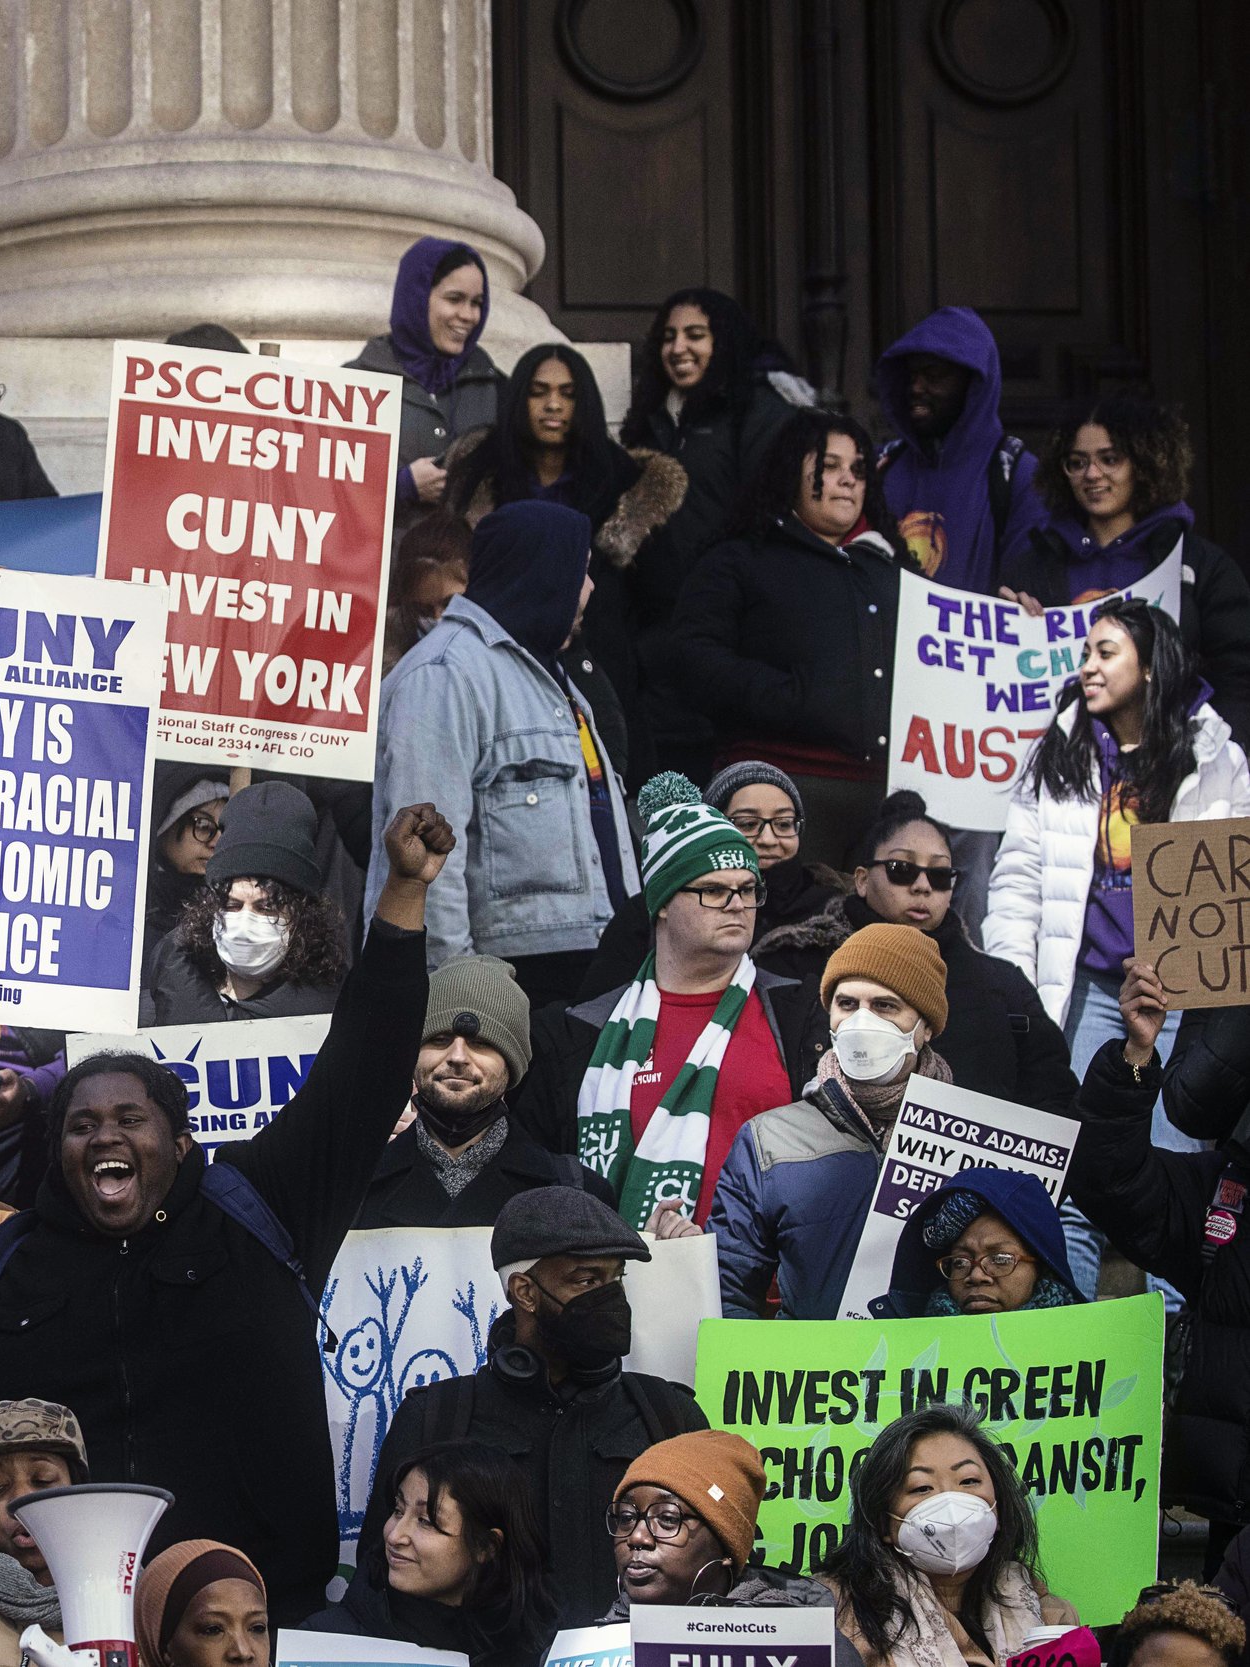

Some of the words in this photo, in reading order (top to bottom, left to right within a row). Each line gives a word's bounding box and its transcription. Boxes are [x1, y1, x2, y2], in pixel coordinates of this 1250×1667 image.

[123, 356, 392, 426] PSC-CUNY
[137, 414, 304, 474] INVEST
[317, 437, 367, 484] IN
[165, 492, 337, 566] CUNY
[304, 588, 353, 634] IN
[927, 591, 1020, 647] THE
[917, 633, 996, 677] GET
[4, 666, 123, 694] ALLIANCE
[232, 649, 367, 716] YORK
[986, 681, 1051, 714] WE
[32, 702, 74, 766] IS
[175, 734, 214, 747] Local
[218, 738, 252, 751] 2334
[262, 743, 286, 755] AFL
[289, 745, 315, 758] CIO
[201, 720, 236, 734] Staff
[239, 724, 299, 741] Congress
[309, 733, 350, 747] CUNY
[1146, 834, 1250, 898] CAR
[1154, 945, 1250, 994] CUT
[160, 1053, 319, 1112] CUN
[188, 1113, 247, 1133] SING
[584, 1130, 620, 1157] CU
[903, 1105, 980, 1144] MAYOR
[983, 1131, 1066, 1168] ADAMS:
[896, 1133, 957, 1168] WHY
[723, 1368, 886, 1426] INVEST
[899, 1366, 950, 1416] IN
[962, 1358, 1107, 1423] GREEN
[997, 1434, 1147, 1503] ANSIT,
[124, 1551, 137, 1595] PYLE
[686, 1621, 778, 1636] #CareNotCuts
